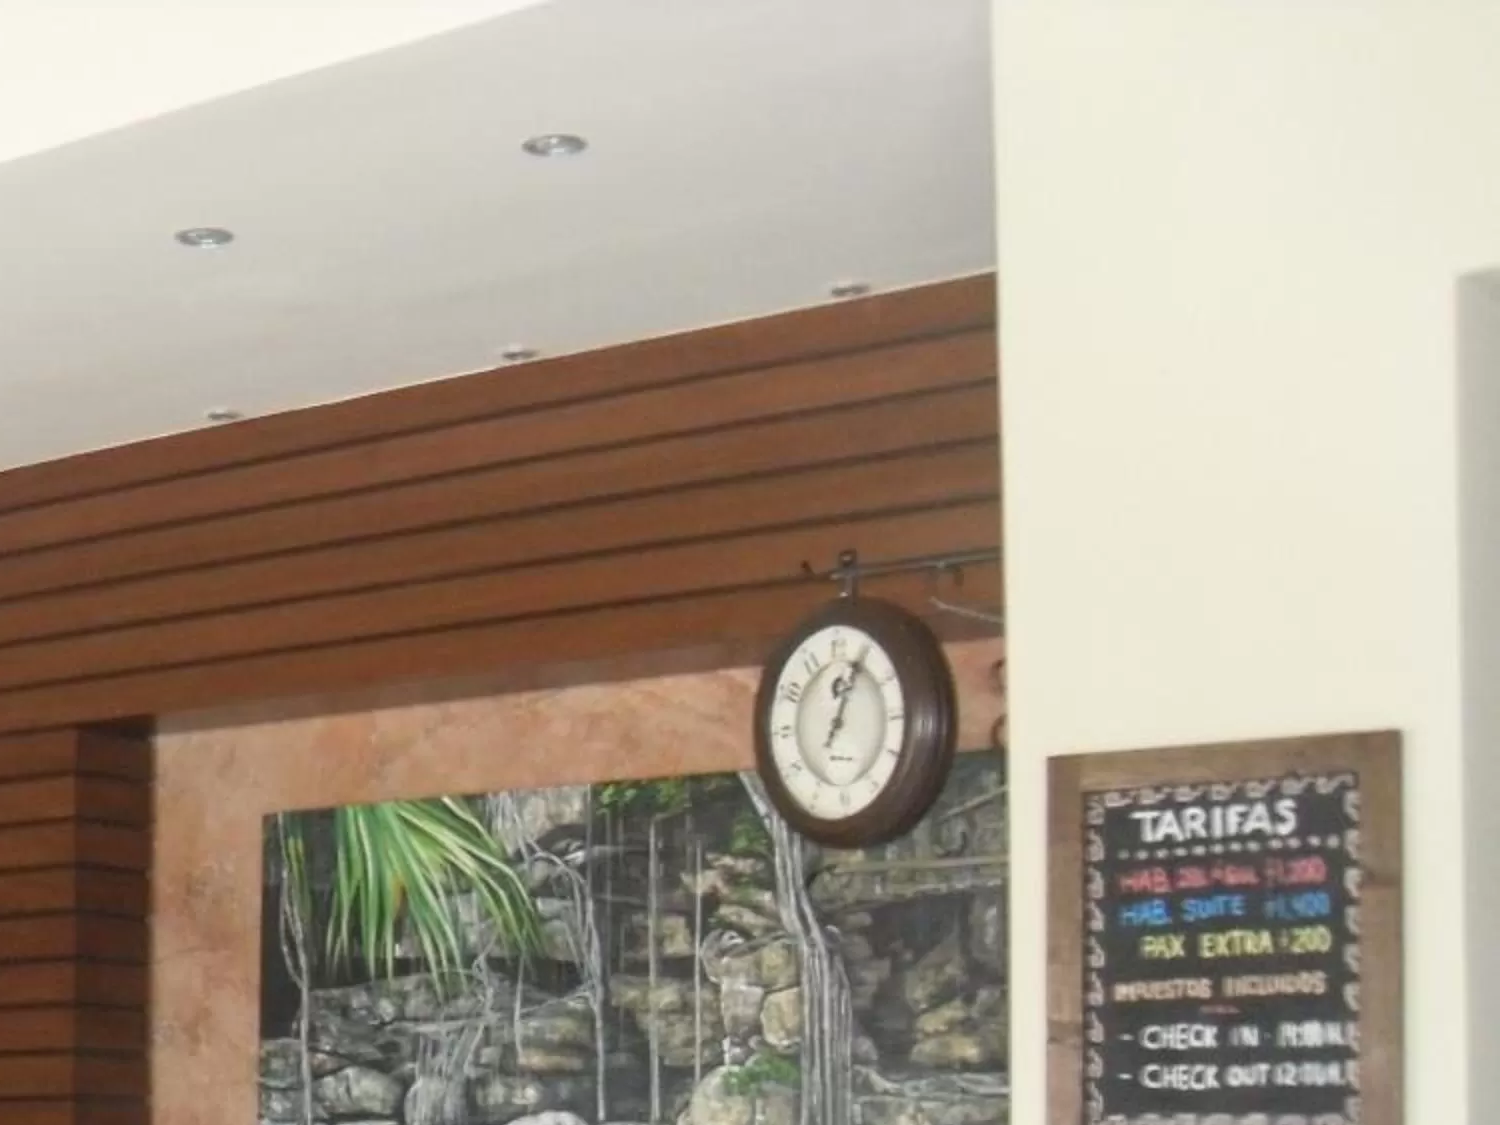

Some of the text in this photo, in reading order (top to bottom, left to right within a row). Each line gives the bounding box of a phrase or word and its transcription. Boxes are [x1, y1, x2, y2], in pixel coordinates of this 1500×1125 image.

[1128, 798, 1298, 843] TARIFAS
[1140, 934, 1186, 960] PAX
[1198, 928, 1274, 958] EXTRA
[1138, 1023, 1219, 1050] CHECK
[1228, 1025, 1260, 1047] IN
[1138, 1063, 1221, 1091] CHECK
[1224, 1062, 1271, 1087] OUT
